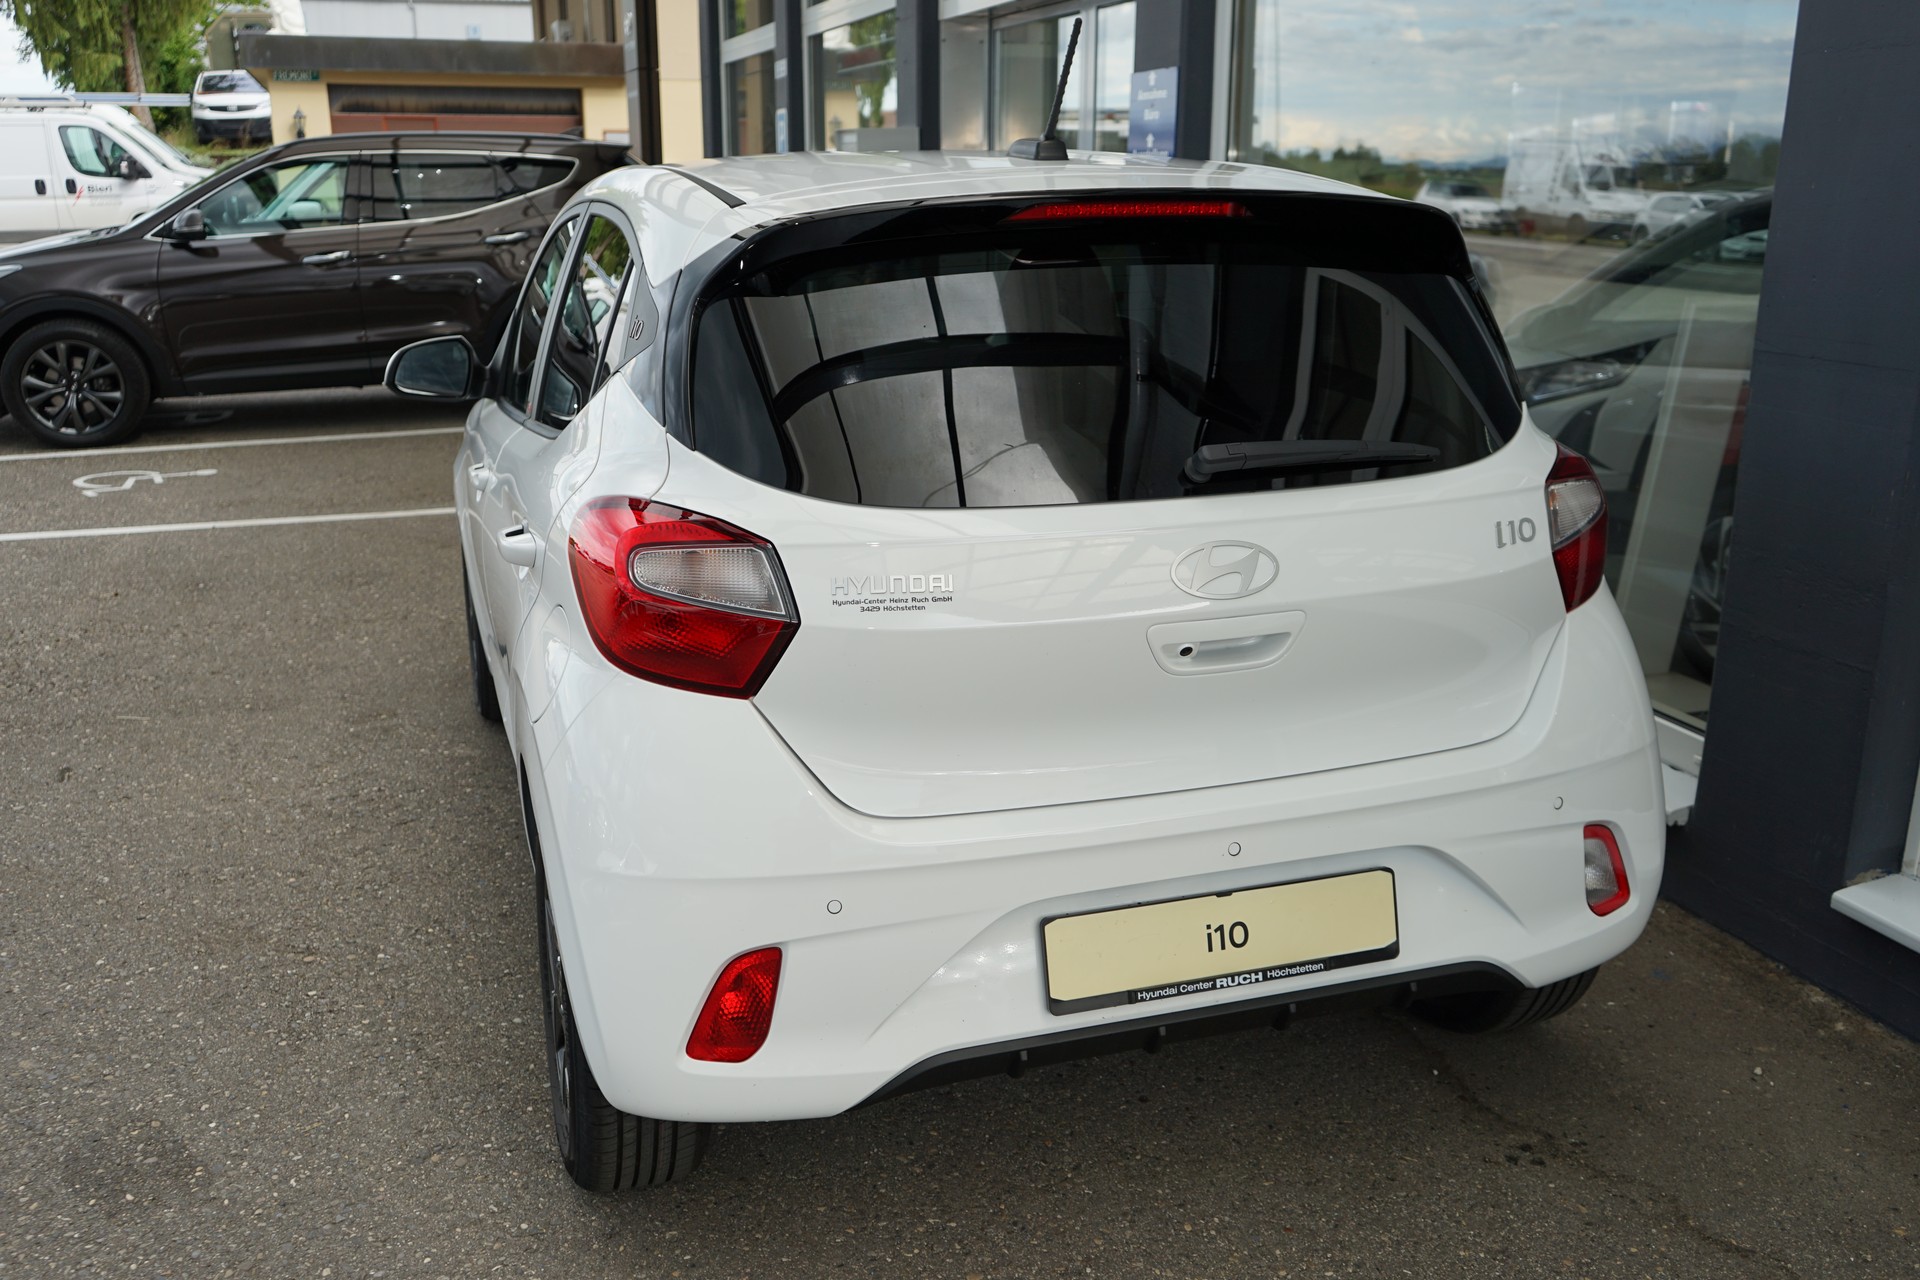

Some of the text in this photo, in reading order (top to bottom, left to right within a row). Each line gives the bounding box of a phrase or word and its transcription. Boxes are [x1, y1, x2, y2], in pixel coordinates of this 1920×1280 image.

[630, 314, 644, 340] i10
[831, 574, 954, 595] HYUNDAI
[832, 598, 887, 606] Hyundai-Center
[1206, 921, 1249, 952] i10
[1138, 962, 1324, 1000] Hyundai Center RUCH Höchstetten
